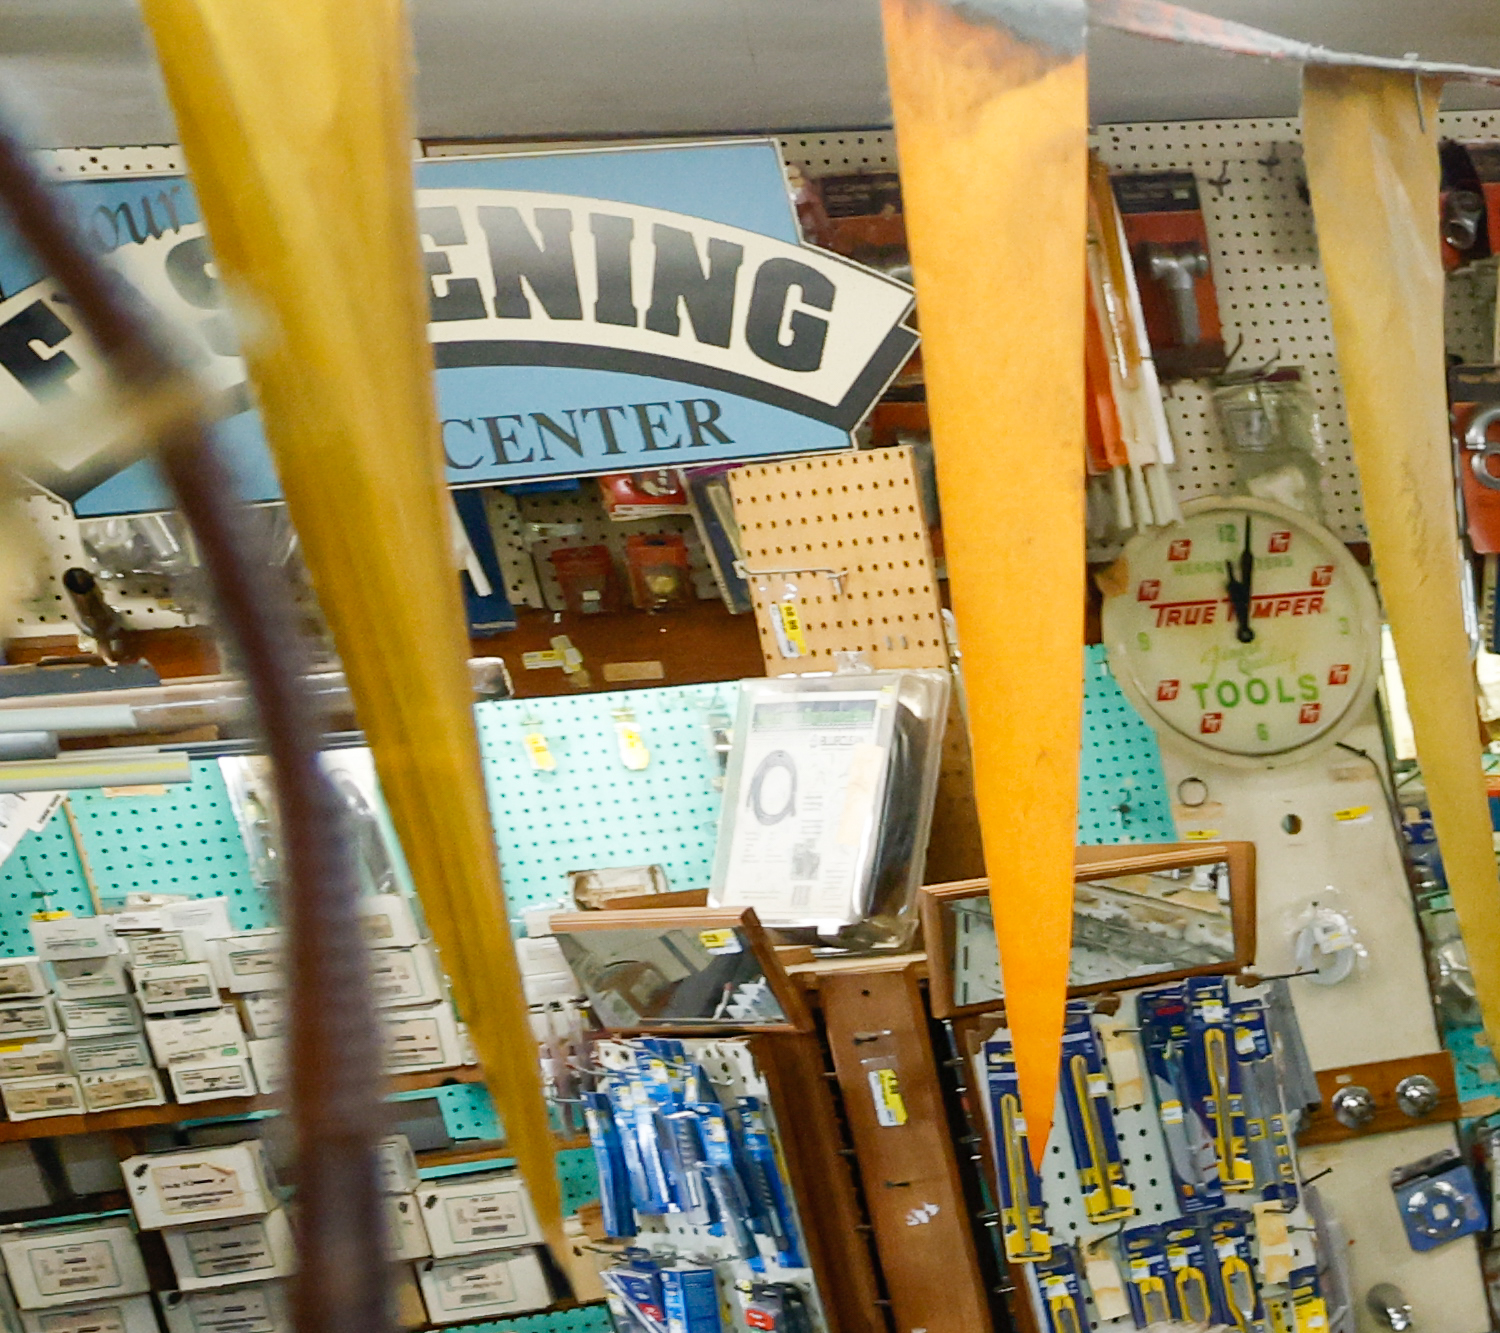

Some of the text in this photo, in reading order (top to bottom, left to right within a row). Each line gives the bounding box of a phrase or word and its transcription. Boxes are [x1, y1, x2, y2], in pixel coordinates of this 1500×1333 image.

[89, 185, 187, 259] our
[439, 398, 737, 470] CENTER
[1150, 601, 1218, 628] TRUE
[1221, 590, 1326, 622] TMPER
[1192, 673, 1320, 709] TOOLS
